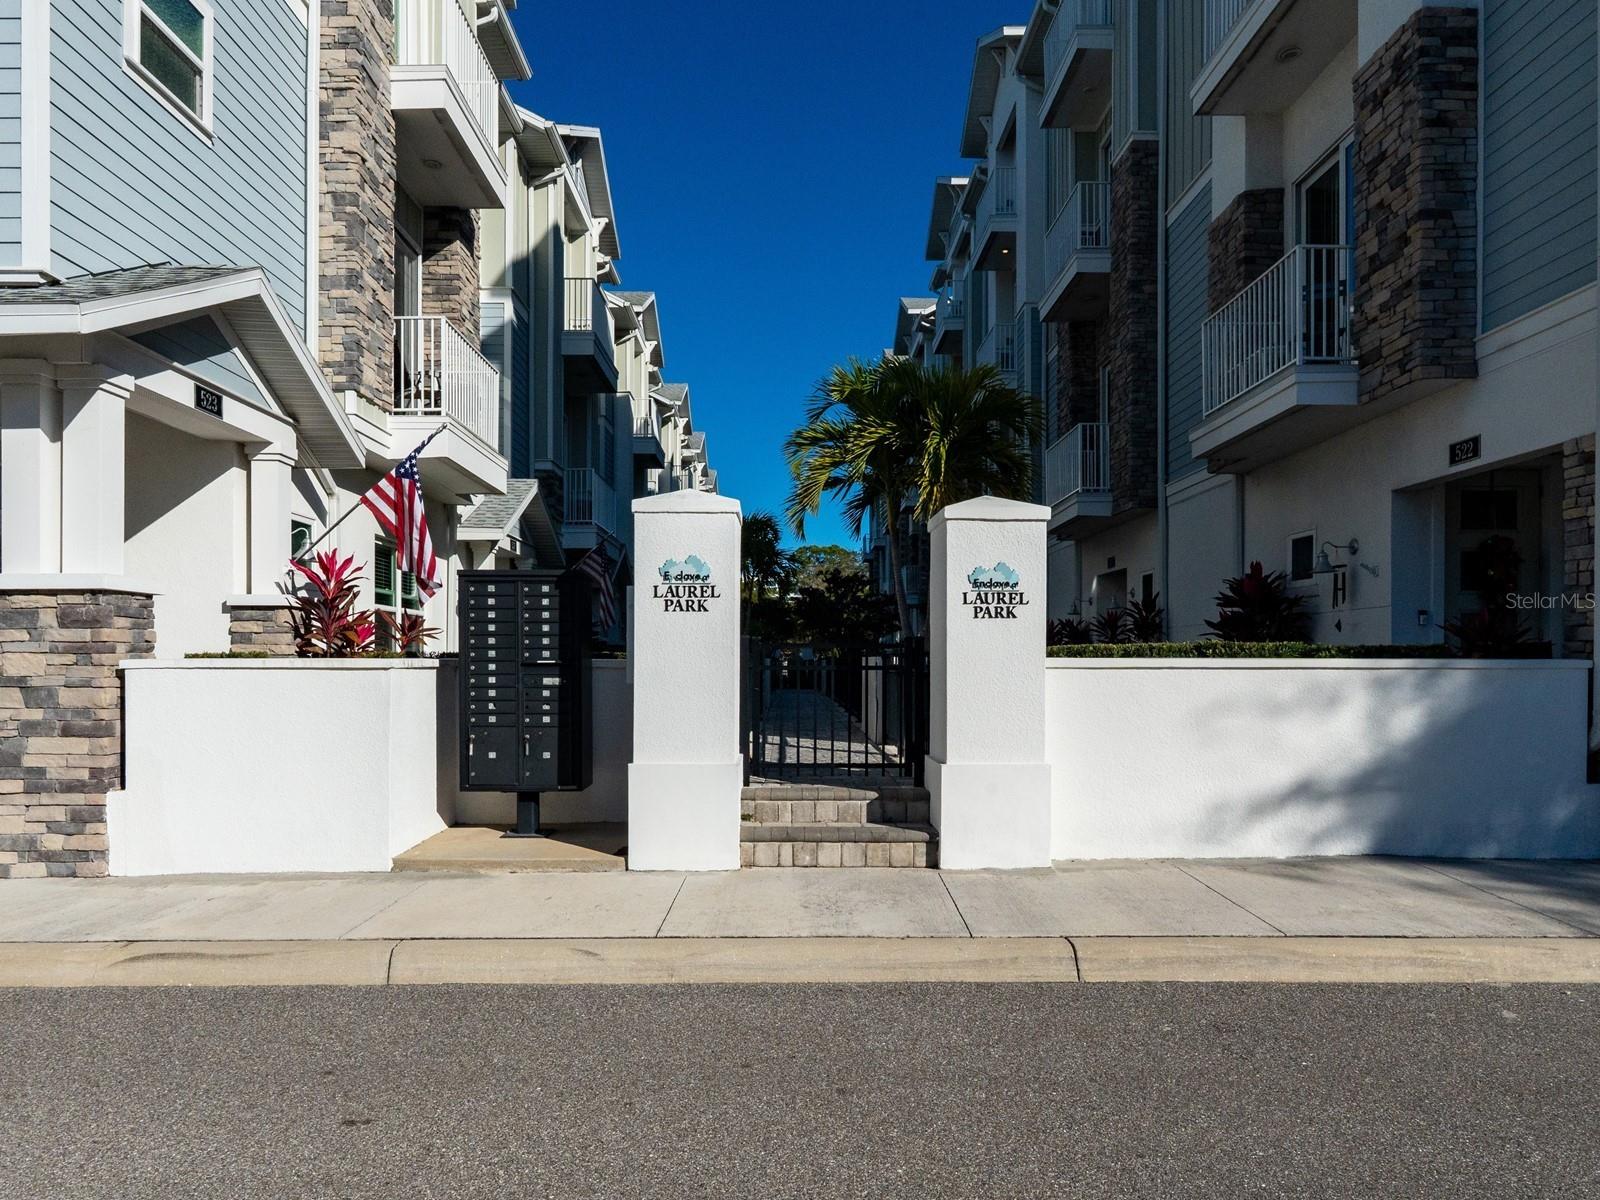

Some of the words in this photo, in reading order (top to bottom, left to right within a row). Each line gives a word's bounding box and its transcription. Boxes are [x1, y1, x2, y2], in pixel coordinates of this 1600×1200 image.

[200, 390, 218, 412] 523
[1455, 441, 1473, 461] 522
[653, 585, 721, 598] LAUREL
[962, 592, 1029, 605] LAUREL
[663, 599, 709, 613] PARK
[973, 606, 1018, 619] PARK
